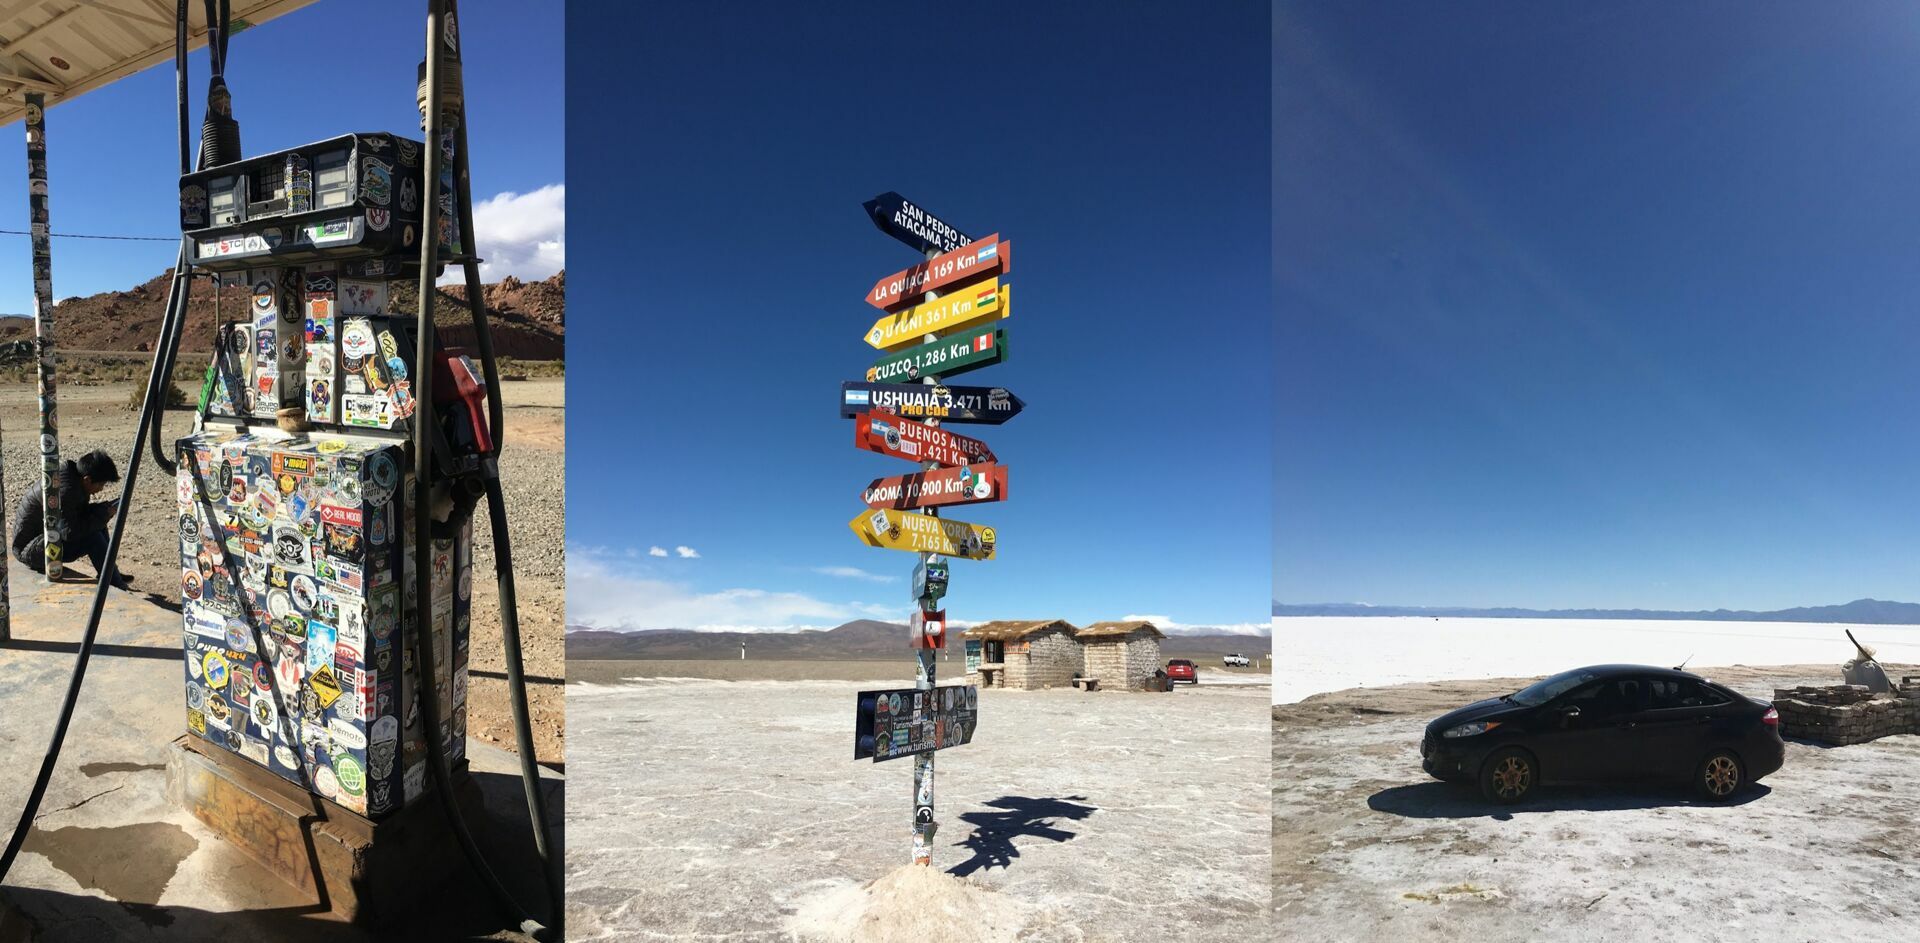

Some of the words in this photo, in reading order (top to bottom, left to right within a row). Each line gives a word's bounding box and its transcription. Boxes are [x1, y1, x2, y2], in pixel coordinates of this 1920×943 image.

[894, 210, 942, 248] ATACAMA
[944, 240, 960, 253] 25
[902, 200, 923, 223] SAN
[926, 214, 957, 242] PEDRO
[960, 234, 972, 247] DE
[875, 286, 886, 301] LA
[889, 270, 931, 295] QUIACA
[934, 260, 954, 280] 169
[957, 254, 976, 271] Km
[885, 315, 923, 338] UYUNI
[926, 306, 947, 325] 361
[952, 301, 972, 317] Km
[875, 358, 912, 381] CUZCO
[915, 348, 947, 370] 1.286
[950, 344, 970, 360] Km
[872, 390, 940, 408] USHUAIA
[943, 394, 982, 411] 3.471
[900, 404, 924, 416] PRO
[925, 405, 949, 417] CDG
[899, 421, 947, 447] BUENOS
[950, 436, 980, 456] AIRES
[917, 442, 947, 462] 1.421
[951, 451, 968, 467] Km
[874, 485, 904, 502] ROMA
[906, 480, 942, 498] 10.900
[945, 477, 963, 495] Km
[902, 515, 939, 535] NUEVA
[941, 522, 968, 541] YORK
[911, 533, 940, 551] 7.165
[943, 538, 959, 554] Km
